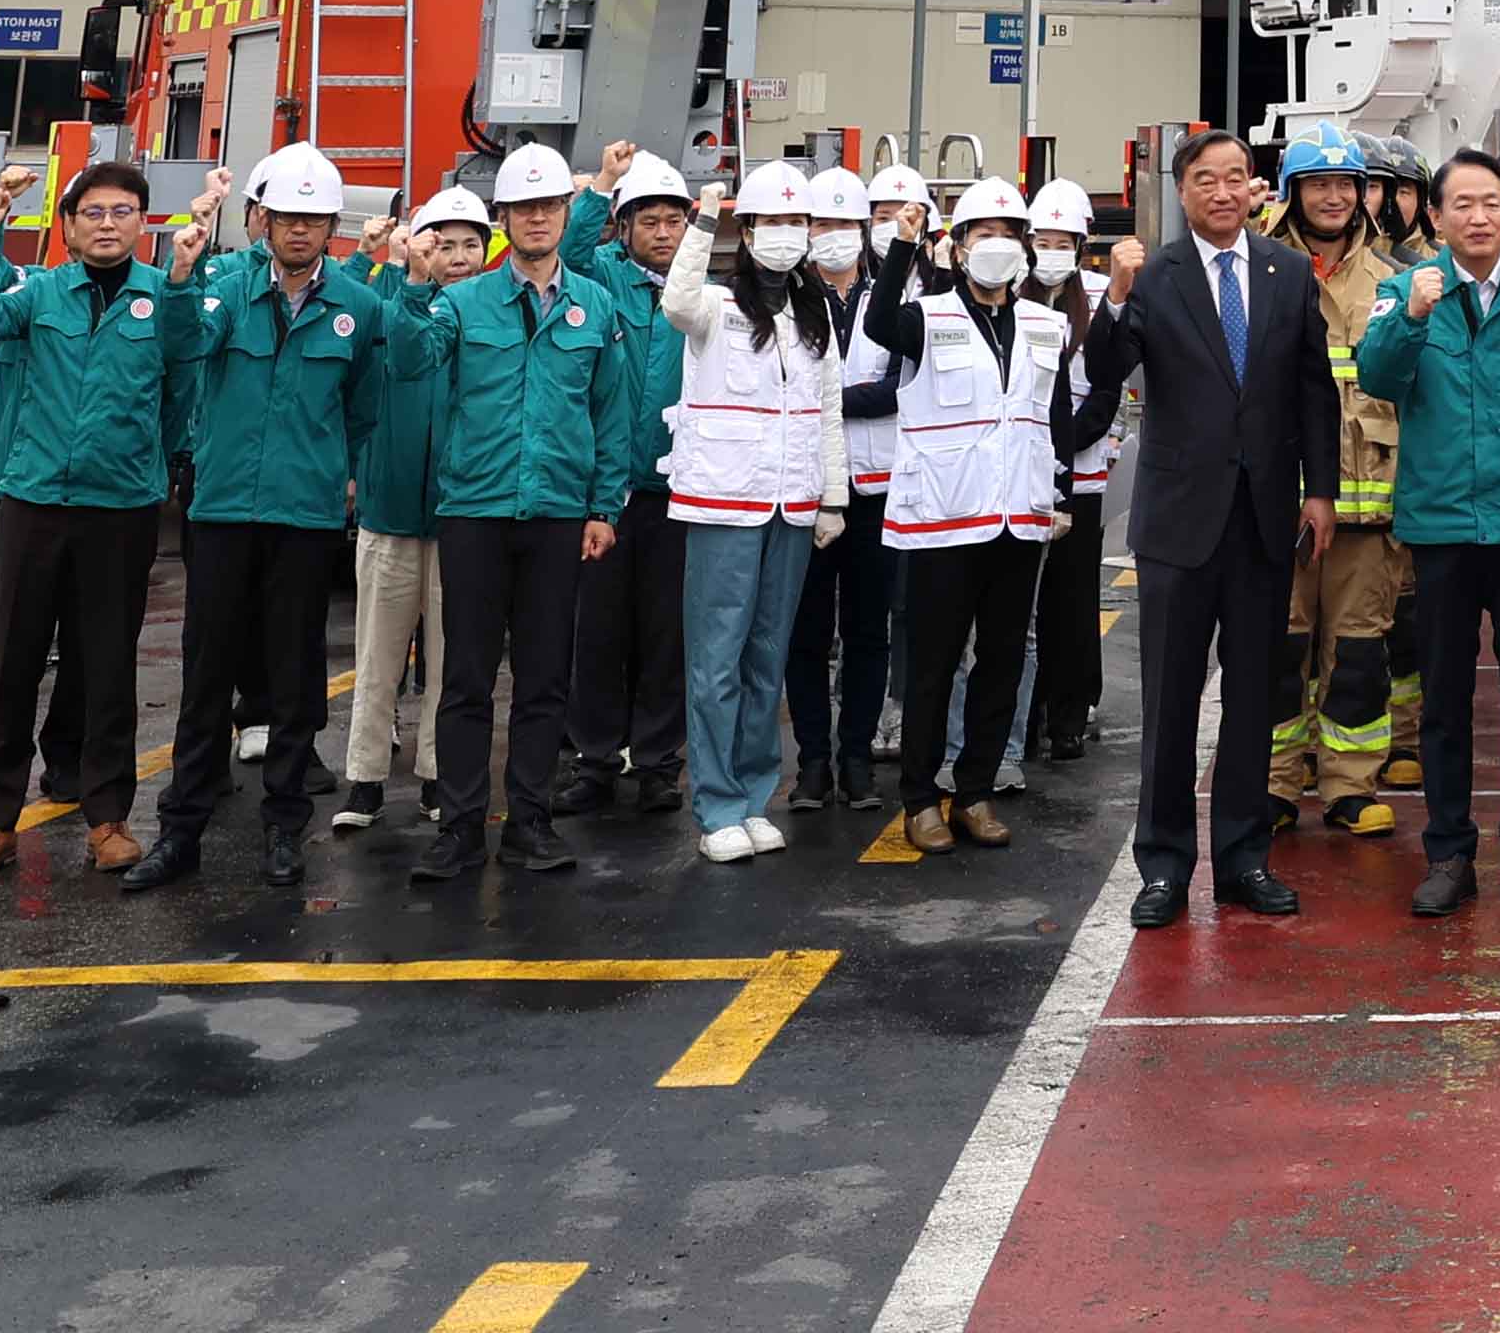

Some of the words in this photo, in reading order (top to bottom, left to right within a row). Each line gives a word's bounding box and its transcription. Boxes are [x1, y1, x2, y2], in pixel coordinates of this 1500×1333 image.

[28, 17, 59, 28] MAST
[10, 31, 42, 43] 보관장
[1002, 68, 1022, 78] 보관
